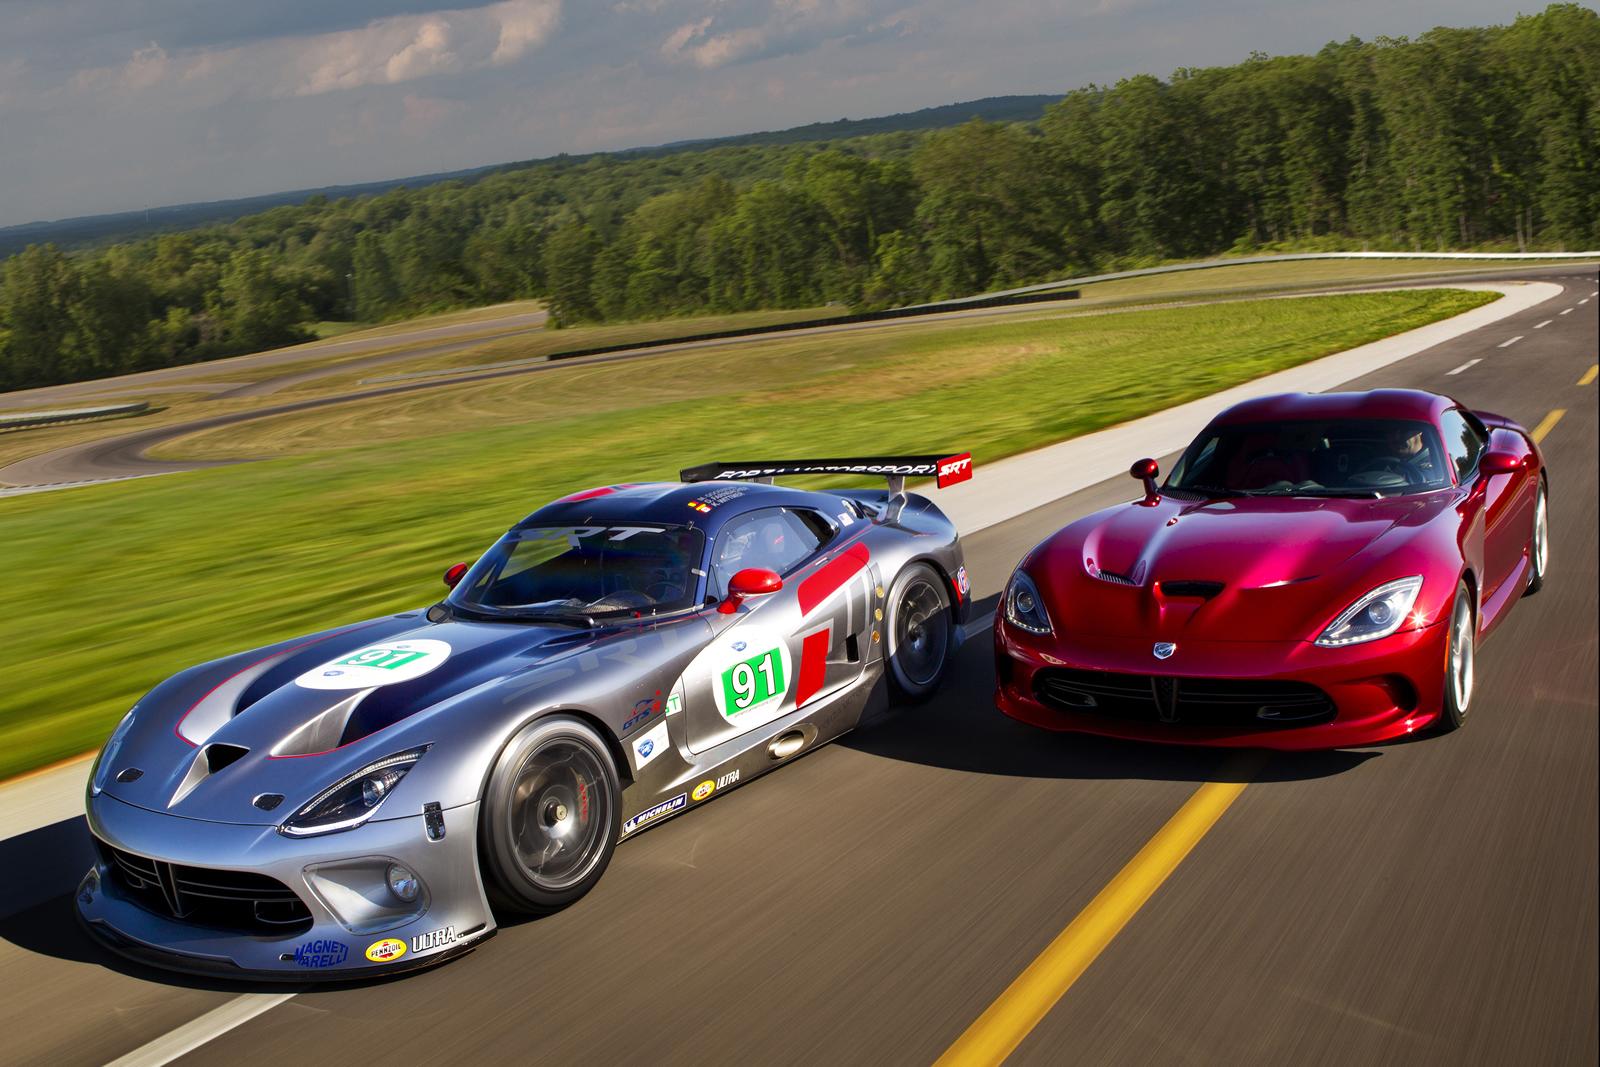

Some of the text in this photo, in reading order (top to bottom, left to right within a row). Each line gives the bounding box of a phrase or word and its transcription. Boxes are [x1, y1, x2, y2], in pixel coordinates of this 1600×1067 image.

[714, 469, 784, 480] FOR
[938, 457, 972, 477] SRT
[347, 649, 417, 667] 91
[731, 652, 777, 709] 91
[716, 769, 740, 790] ULTRA
[637, 797, 683, 824] MICHELIN
[411, 926, 456, 953] ULTRA
[371, 943, 402, 957] PENNZOIL
